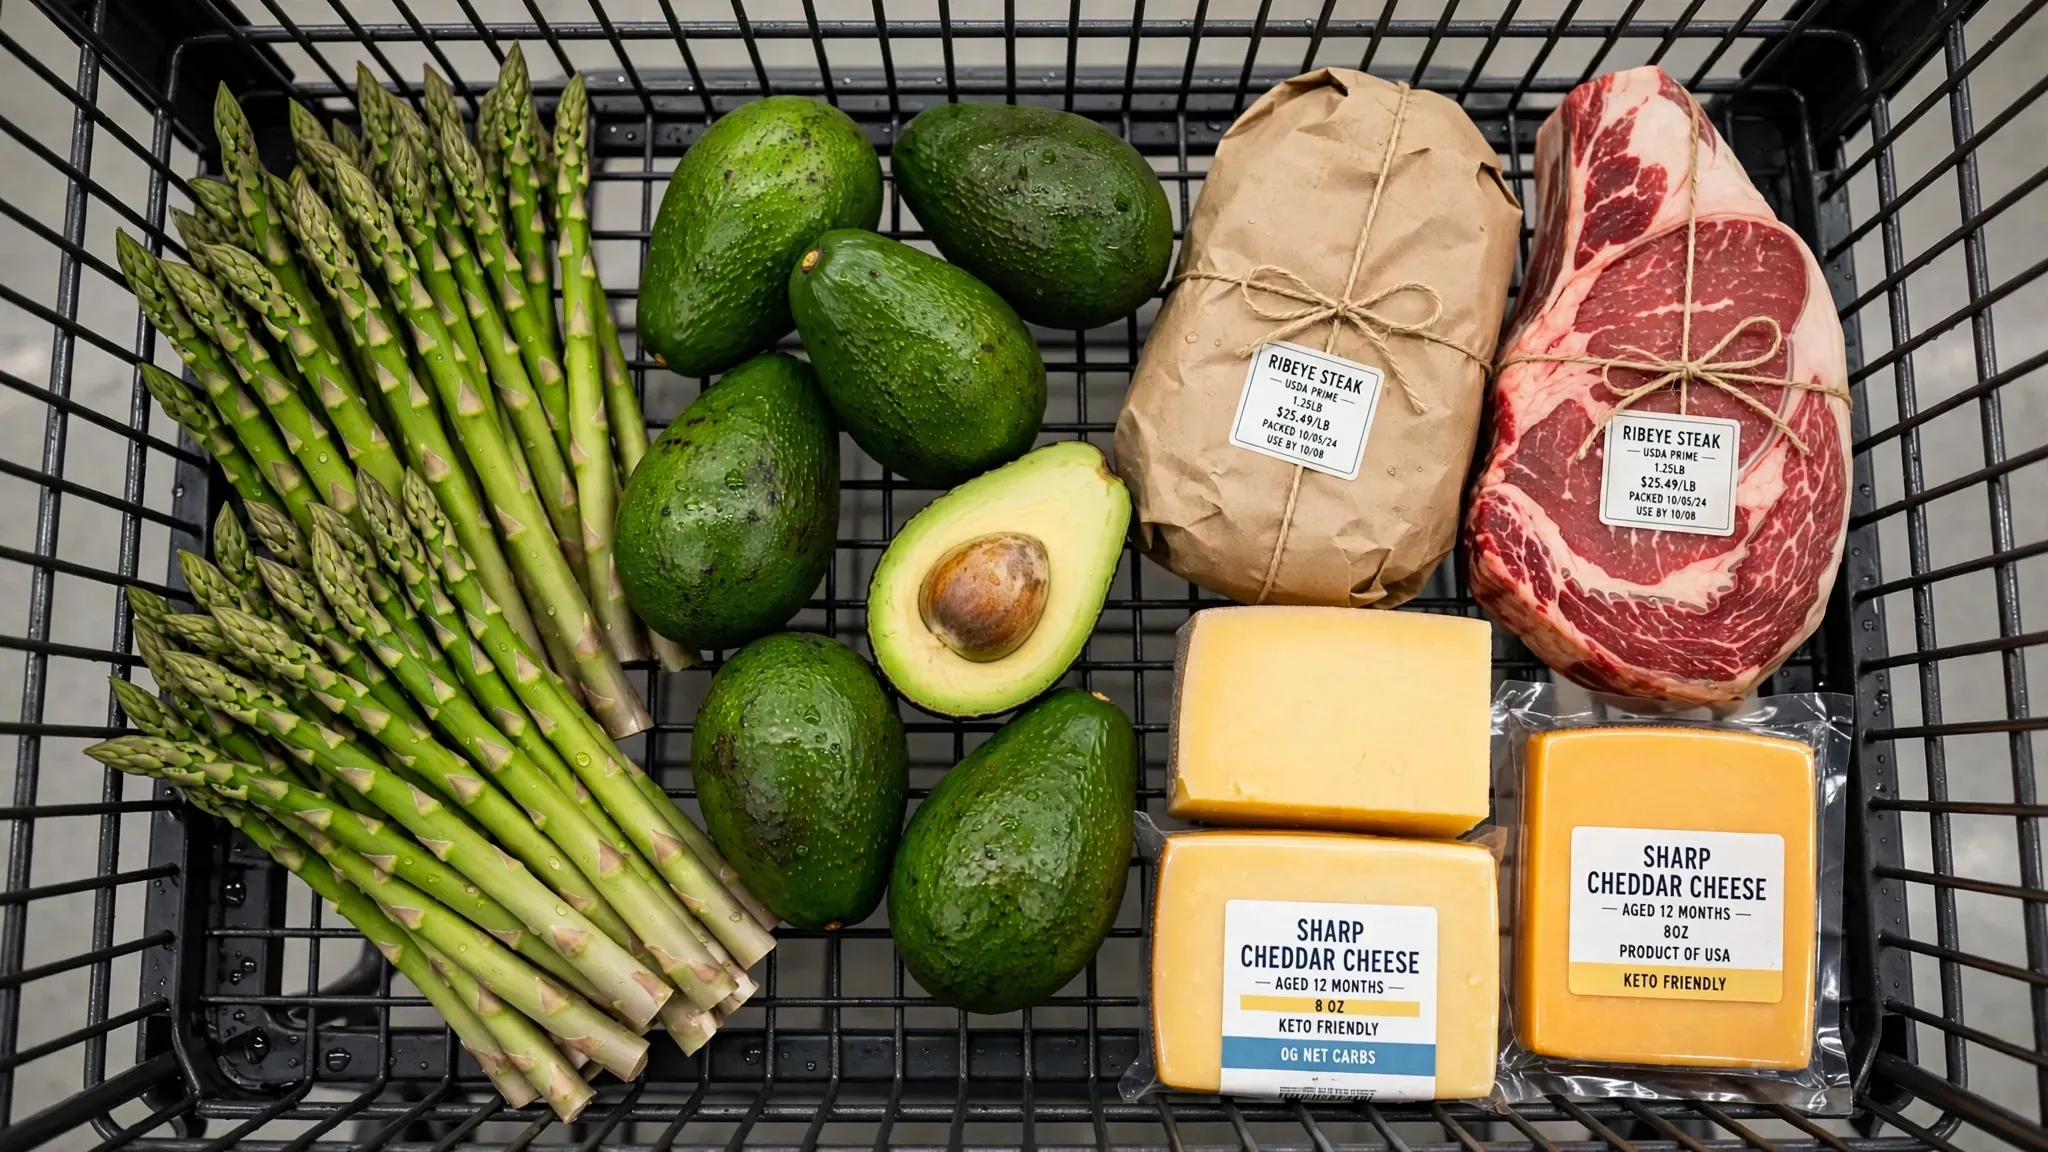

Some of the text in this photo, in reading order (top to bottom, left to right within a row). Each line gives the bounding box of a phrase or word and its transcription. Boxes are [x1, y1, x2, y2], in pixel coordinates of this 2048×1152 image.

[1268, 354, 1363, 394] RIBEYE STEAK
[1285, 379, 1338, 403] USDA PRIME
[1293, 396, 1322, 412] 1.25LB
[1277, 406, 1330, 431] $25.49/LB
[1262, 419, 1337, 448] PACKED 10/05/24
[1623, 425, 1720, 449] RIBEYE STEAK
[1267, 434, 1324, 459] USE BY 10/08
[1644, 448, 1698, 461] USDA PRIME
[1655, 463, 1685, 474] 1.25LB
[1641, 476, 1696, 492] $25.49/LB
[1629, 491, 1706, 507] PACKED 10/05/24
[1636, 506, 1696, 520] USE BY 10/08
[1643, 845, 1711, 870] SHARP
[1588, 871, 1767, 900] CHEDDAR CHEESE
[1622, 903, 1731, 920] AGED 12 MONTHS
[1297, 918, 1364, 943] SHARP
[1664, 925, 1689, 939] 8OZ
[1241, 944, 1419, 974] CHEDDAR CHEESE
[1620, 944, 1730, 962] PRODUCT OF USA
[1276, 977, 1384, 994] AGED 12 MONTHS
[1624, 973, 1726, 991] KETO FRIENDLY
[1315, 999, 1344, 1013] 8 OZ
[1279, 1019, 1379, 1036] KETO FRIENDLY
[1303, 1048, 1328, 1062] NET
[1332, 1049, 1376, 1064] CARBS
